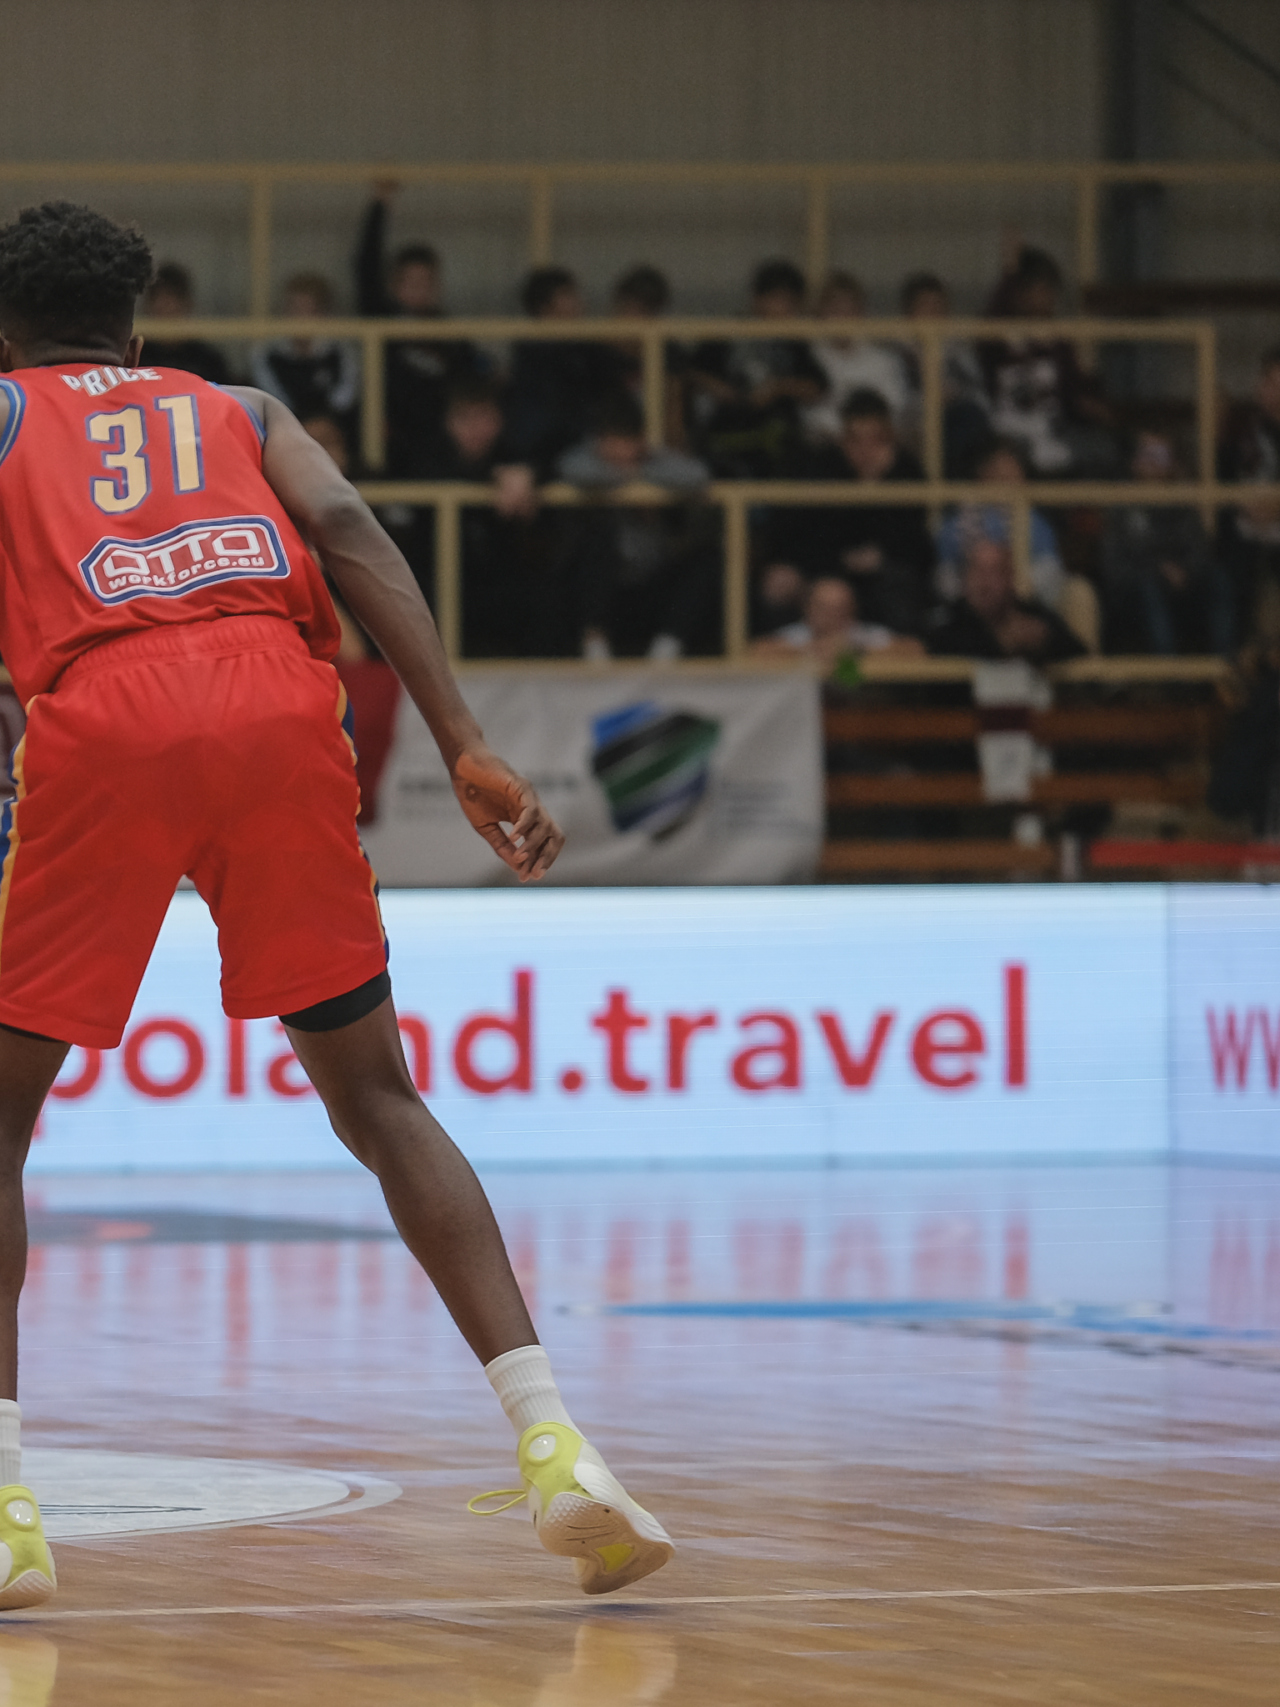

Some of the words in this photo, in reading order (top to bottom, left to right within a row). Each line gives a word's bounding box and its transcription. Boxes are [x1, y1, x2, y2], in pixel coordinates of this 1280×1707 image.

[59, 366, 162, 397] PRICE
[85, 394, 205, 516] 31
[102, 530, 261, 578] OTTO
[108, 556, 265, 590] workforce.eu
